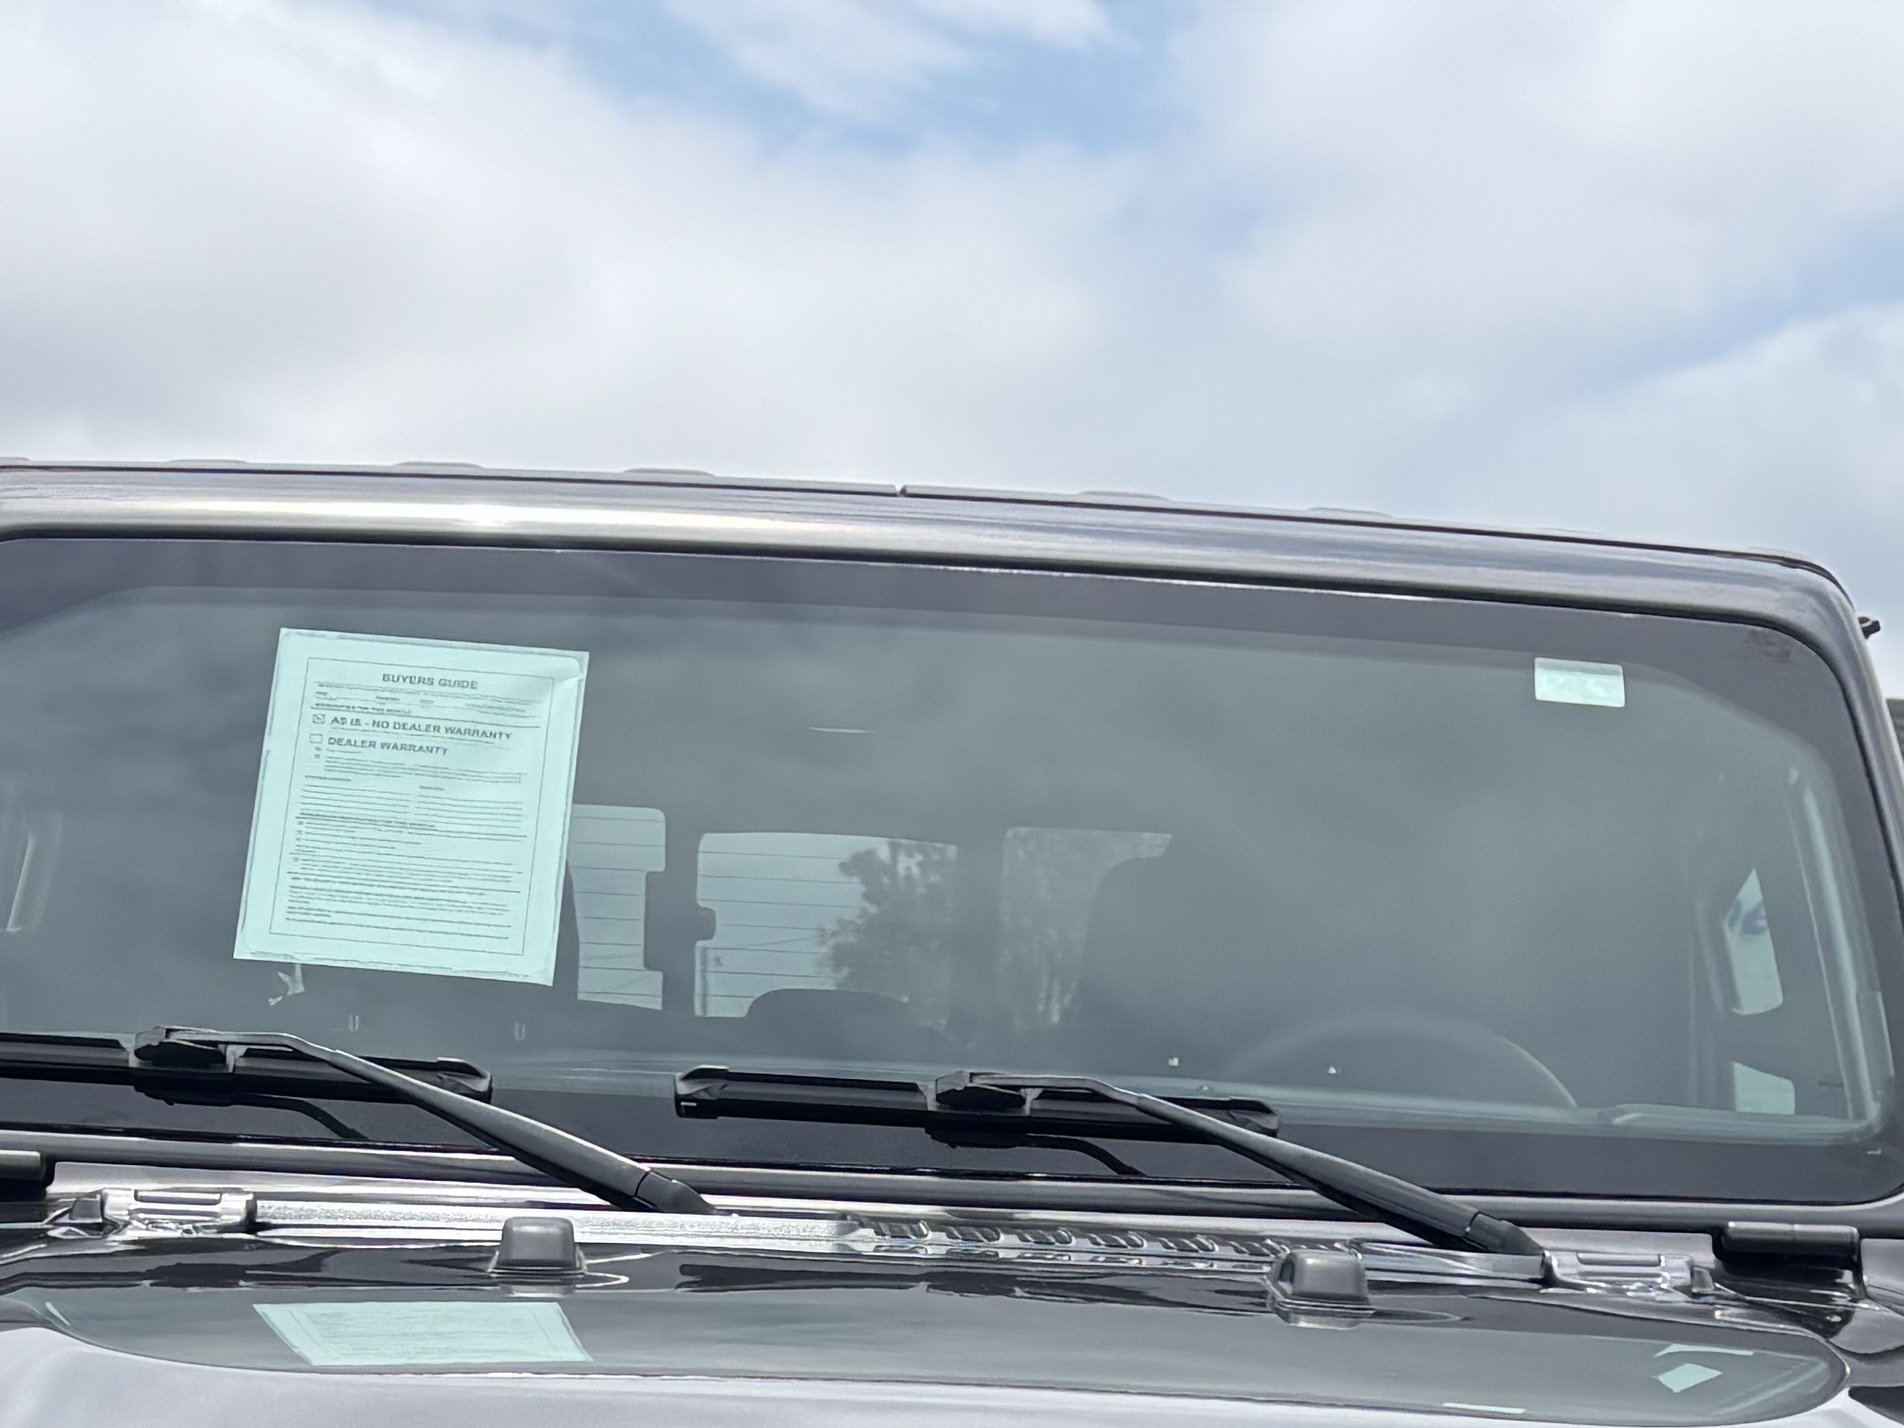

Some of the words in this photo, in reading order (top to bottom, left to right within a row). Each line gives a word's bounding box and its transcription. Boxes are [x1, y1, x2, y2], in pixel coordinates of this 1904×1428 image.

[381, 673, 435, 687] BUYERS
[438, 678, 479, 690] GUIDE
[372, 719, 390, 729] NO
[393, 721, 442, 734] DEALER
[444, 726, 513, 740] WARRANTY
[327, 736, 377, 749] DEALER
[380, 742, 448, 756] WARRANTY
